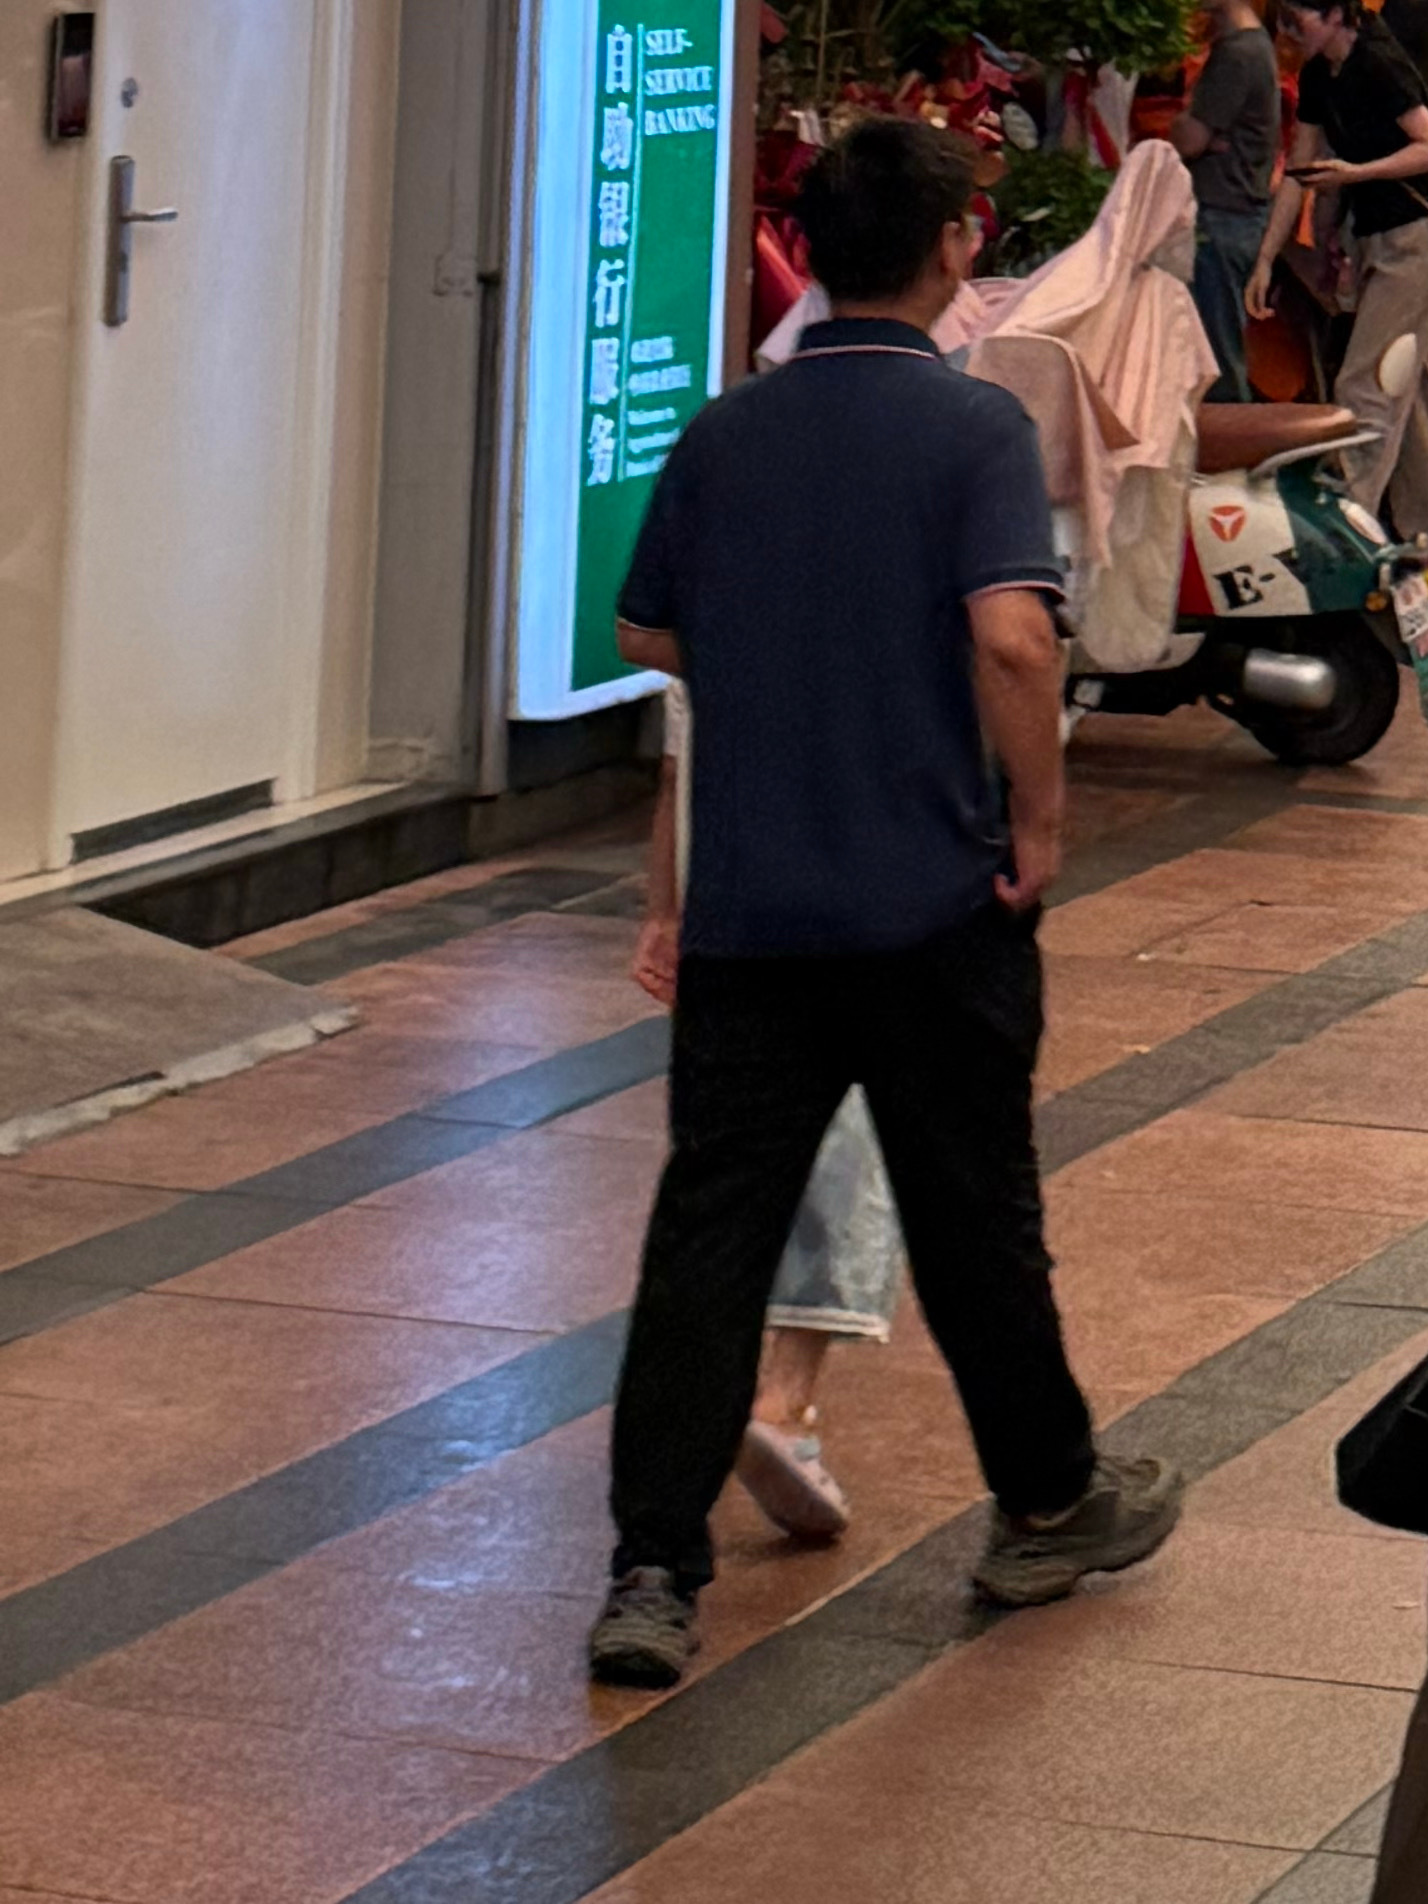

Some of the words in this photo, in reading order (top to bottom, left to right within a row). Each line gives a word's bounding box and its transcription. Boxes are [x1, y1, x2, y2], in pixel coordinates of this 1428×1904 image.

[586, 24, 634, 486] 自助银行服务
